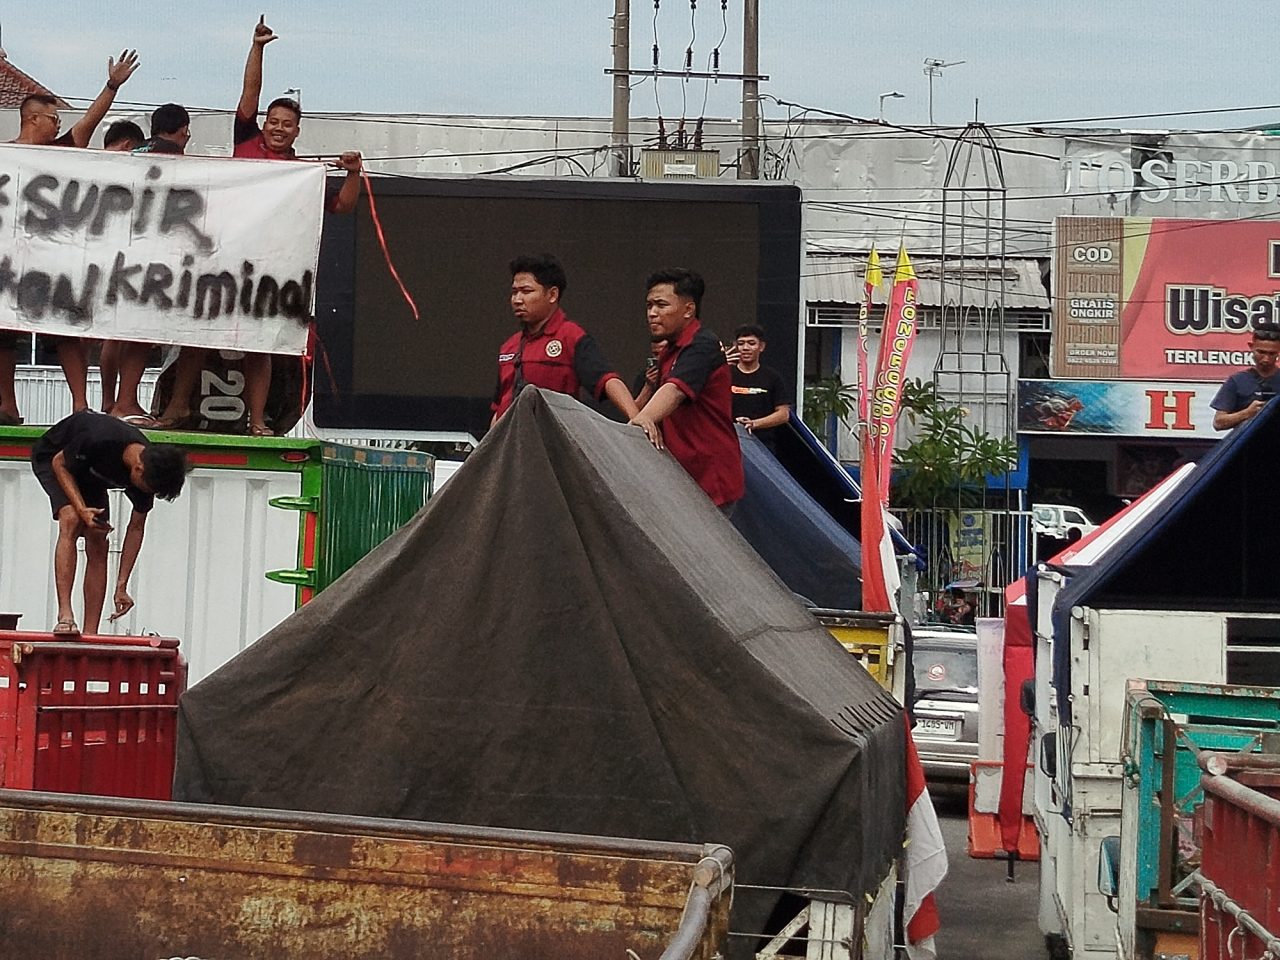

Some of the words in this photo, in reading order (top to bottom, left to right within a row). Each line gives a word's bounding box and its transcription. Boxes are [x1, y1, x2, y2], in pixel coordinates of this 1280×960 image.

[1060, 155, 1280, 205] TOSERB
[1073, 247, 1113, 262] COD
[1070, 298, 1115, 309] GRATIS
[1070, 308, 1114, 319] ONGKIR
[1165, 349, 1257, 366] TERLENGK
